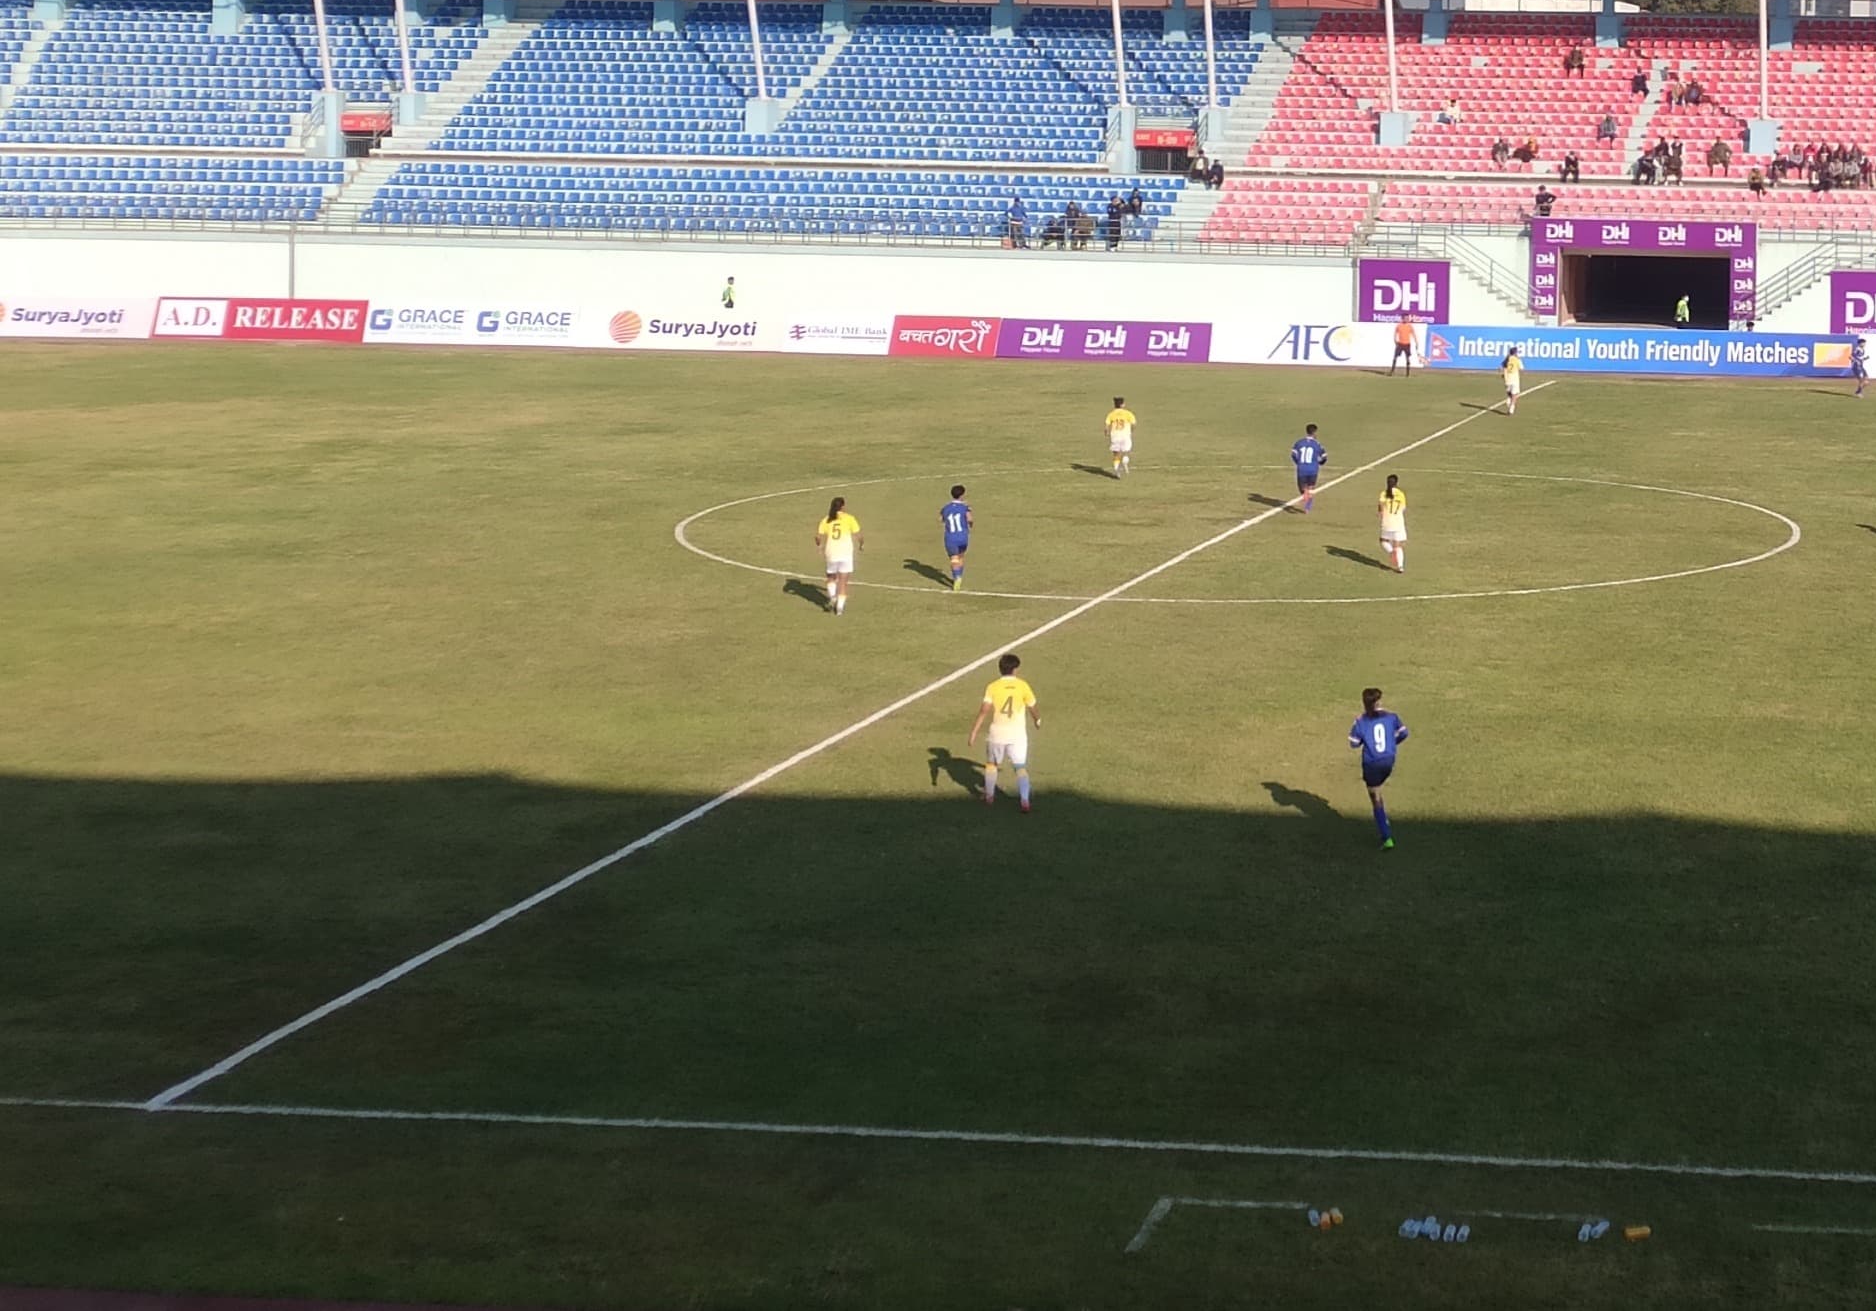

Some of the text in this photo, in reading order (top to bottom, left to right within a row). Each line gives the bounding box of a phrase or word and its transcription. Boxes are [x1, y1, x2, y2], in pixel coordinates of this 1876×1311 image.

[11, 308, 125, 325] SuryaJyoti
[163, 306, 360, 330] A.D. RELEASE
[398, 309, 465, 324] GRACE
[505, 311, 571, 326] GRACE
[649, 319, 757, 338] SuryaJyoti
[1268, 324, 1351, 361] AFC
[1459, 336, 1809, 367] International Youth Friendly Matches
[1300, 446, 1314, 464] 10
[832, 523, 842, 541] 5
[947, 513, 963, 533] 11
[1000, 695, 1014, 720] 4
[1373, 723, 1387, 754] 9
